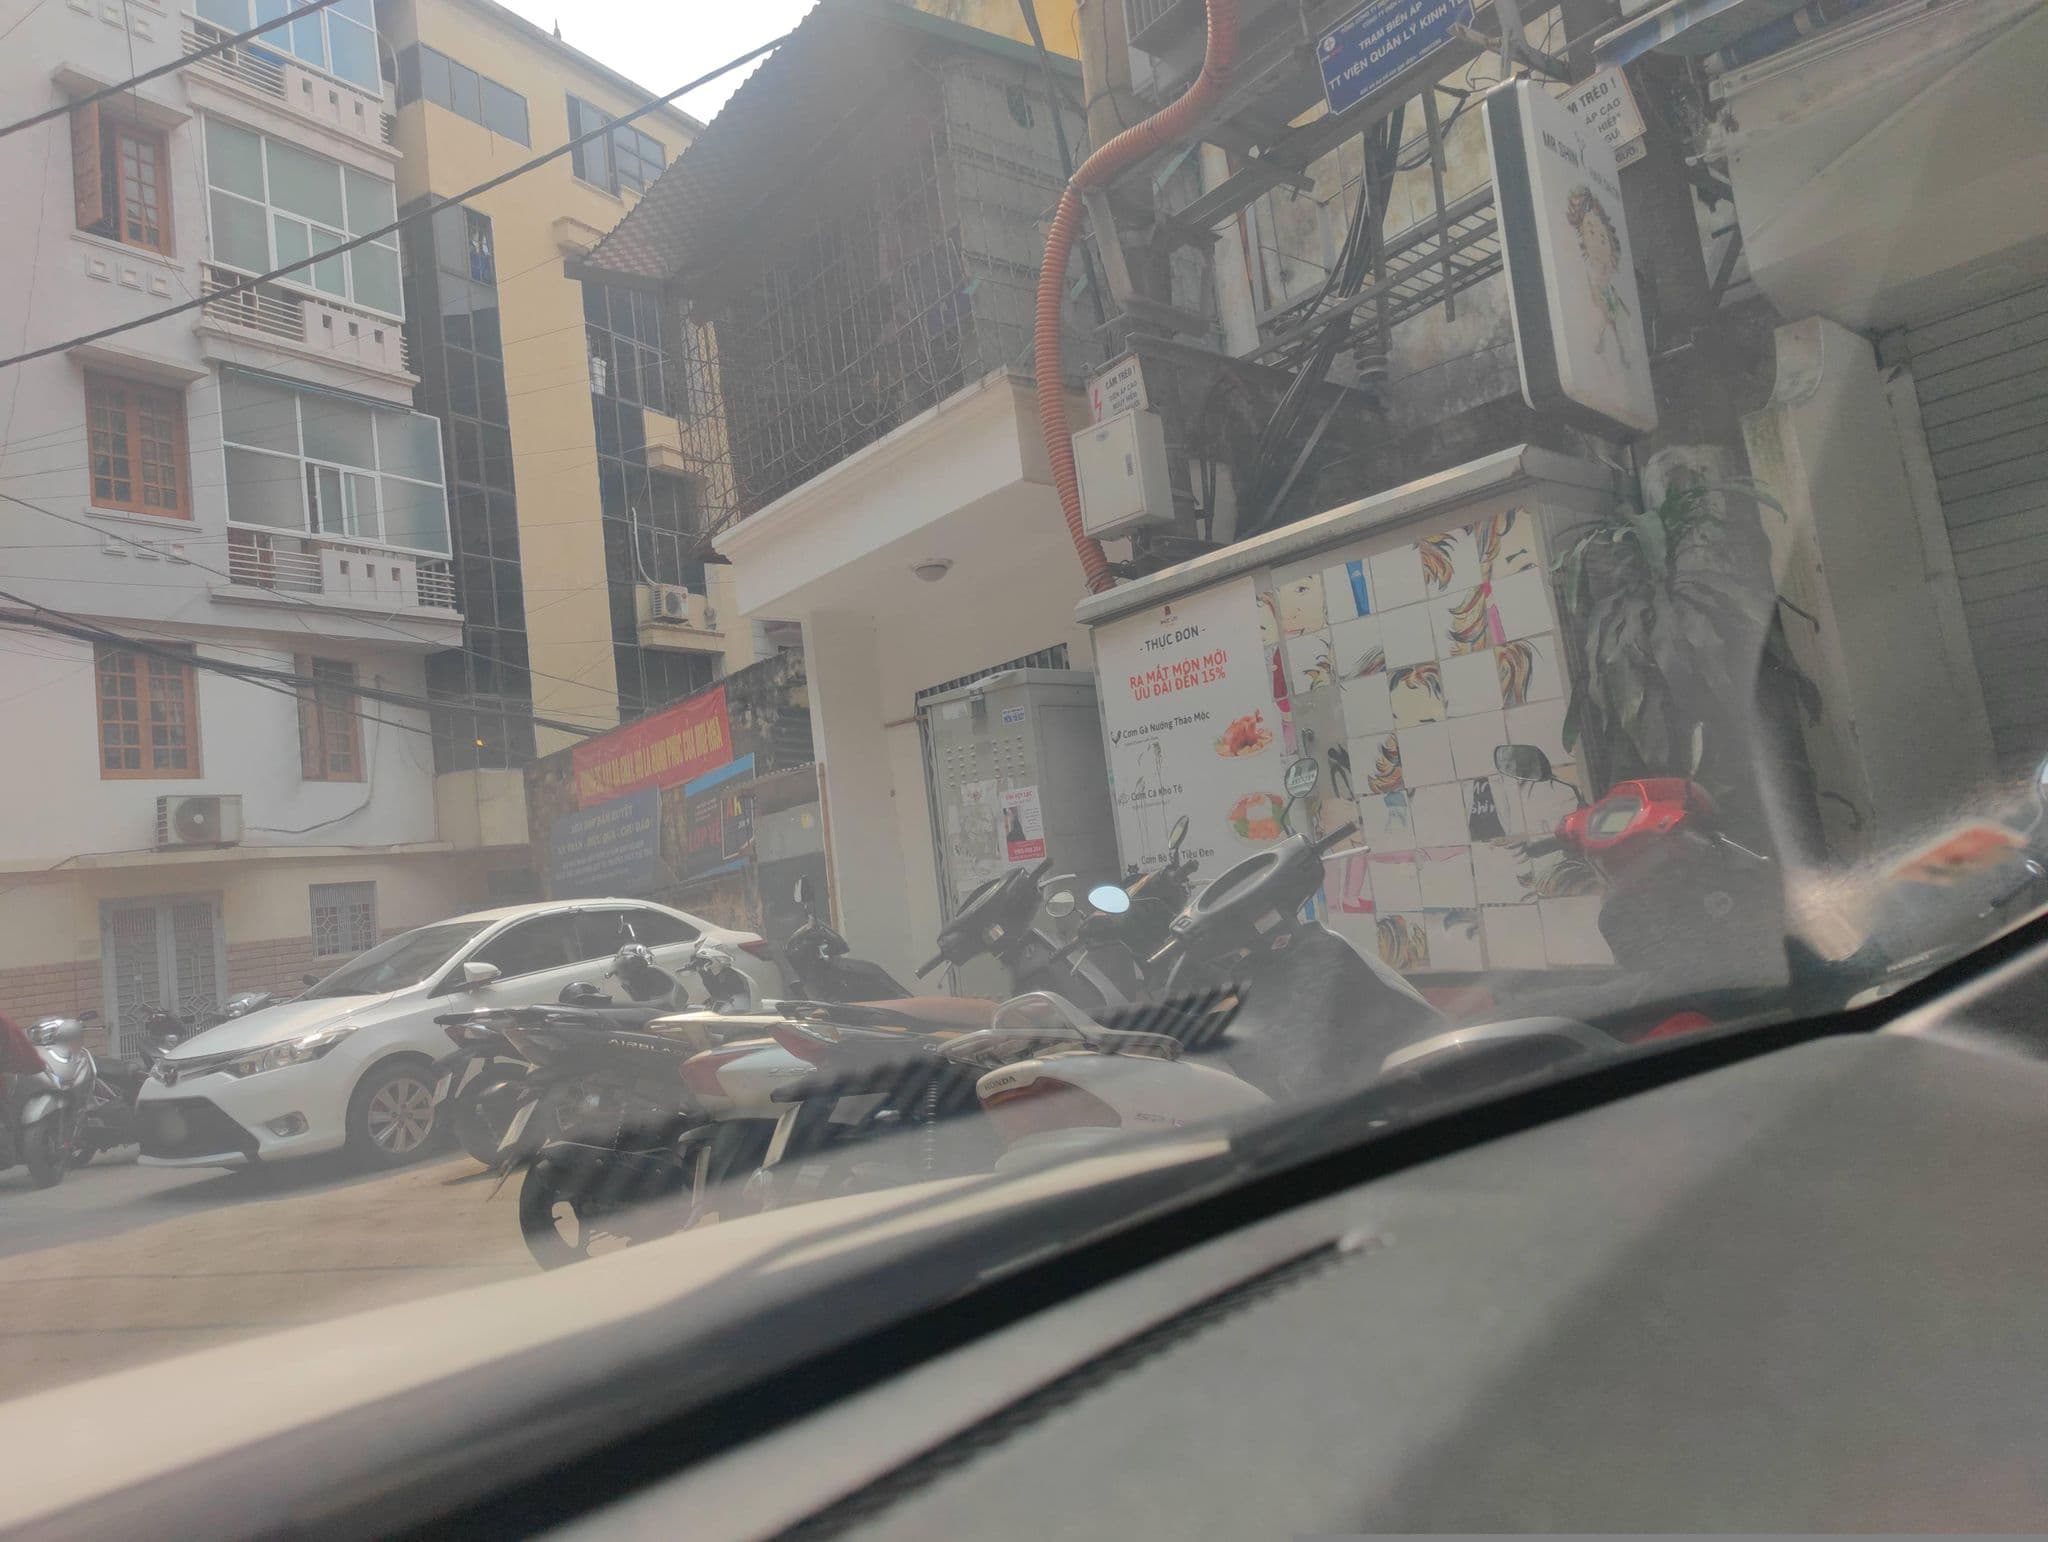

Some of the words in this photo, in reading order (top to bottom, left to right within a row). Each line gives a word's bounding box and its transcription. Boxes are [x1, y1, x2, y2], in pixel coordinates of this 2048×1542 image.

[1358, 29, 1386, 52] TRẠM
[1386, 12, 1408, 34] BIẾN
[1410, 0, 1423, 17] ÁP
[1328, 77, 1341, 91] TT
[1343, 57, 1368, 82] VIỆN
[1370, 34, 1402, 64] QUẢN
[1403, 22, 1417, 42] LÝ
[1419, 3, 1448, 31] KINH
[1579, 81, 1609, 109] TRÈO
[1585, 109, 1598, 126] ÁP
[1600, 97, 1622, 116] CAO
[1145, 632, 1173, 652] THỰC
[1129, 674, 1145, 690] RA
[1203, 648, 1228, 669] MỚI
[1134, 685, 1151, 702] ƯU
[1201, 666, 1227, 684] 15%
[984, 1074, 1017, 1091] HONDA
